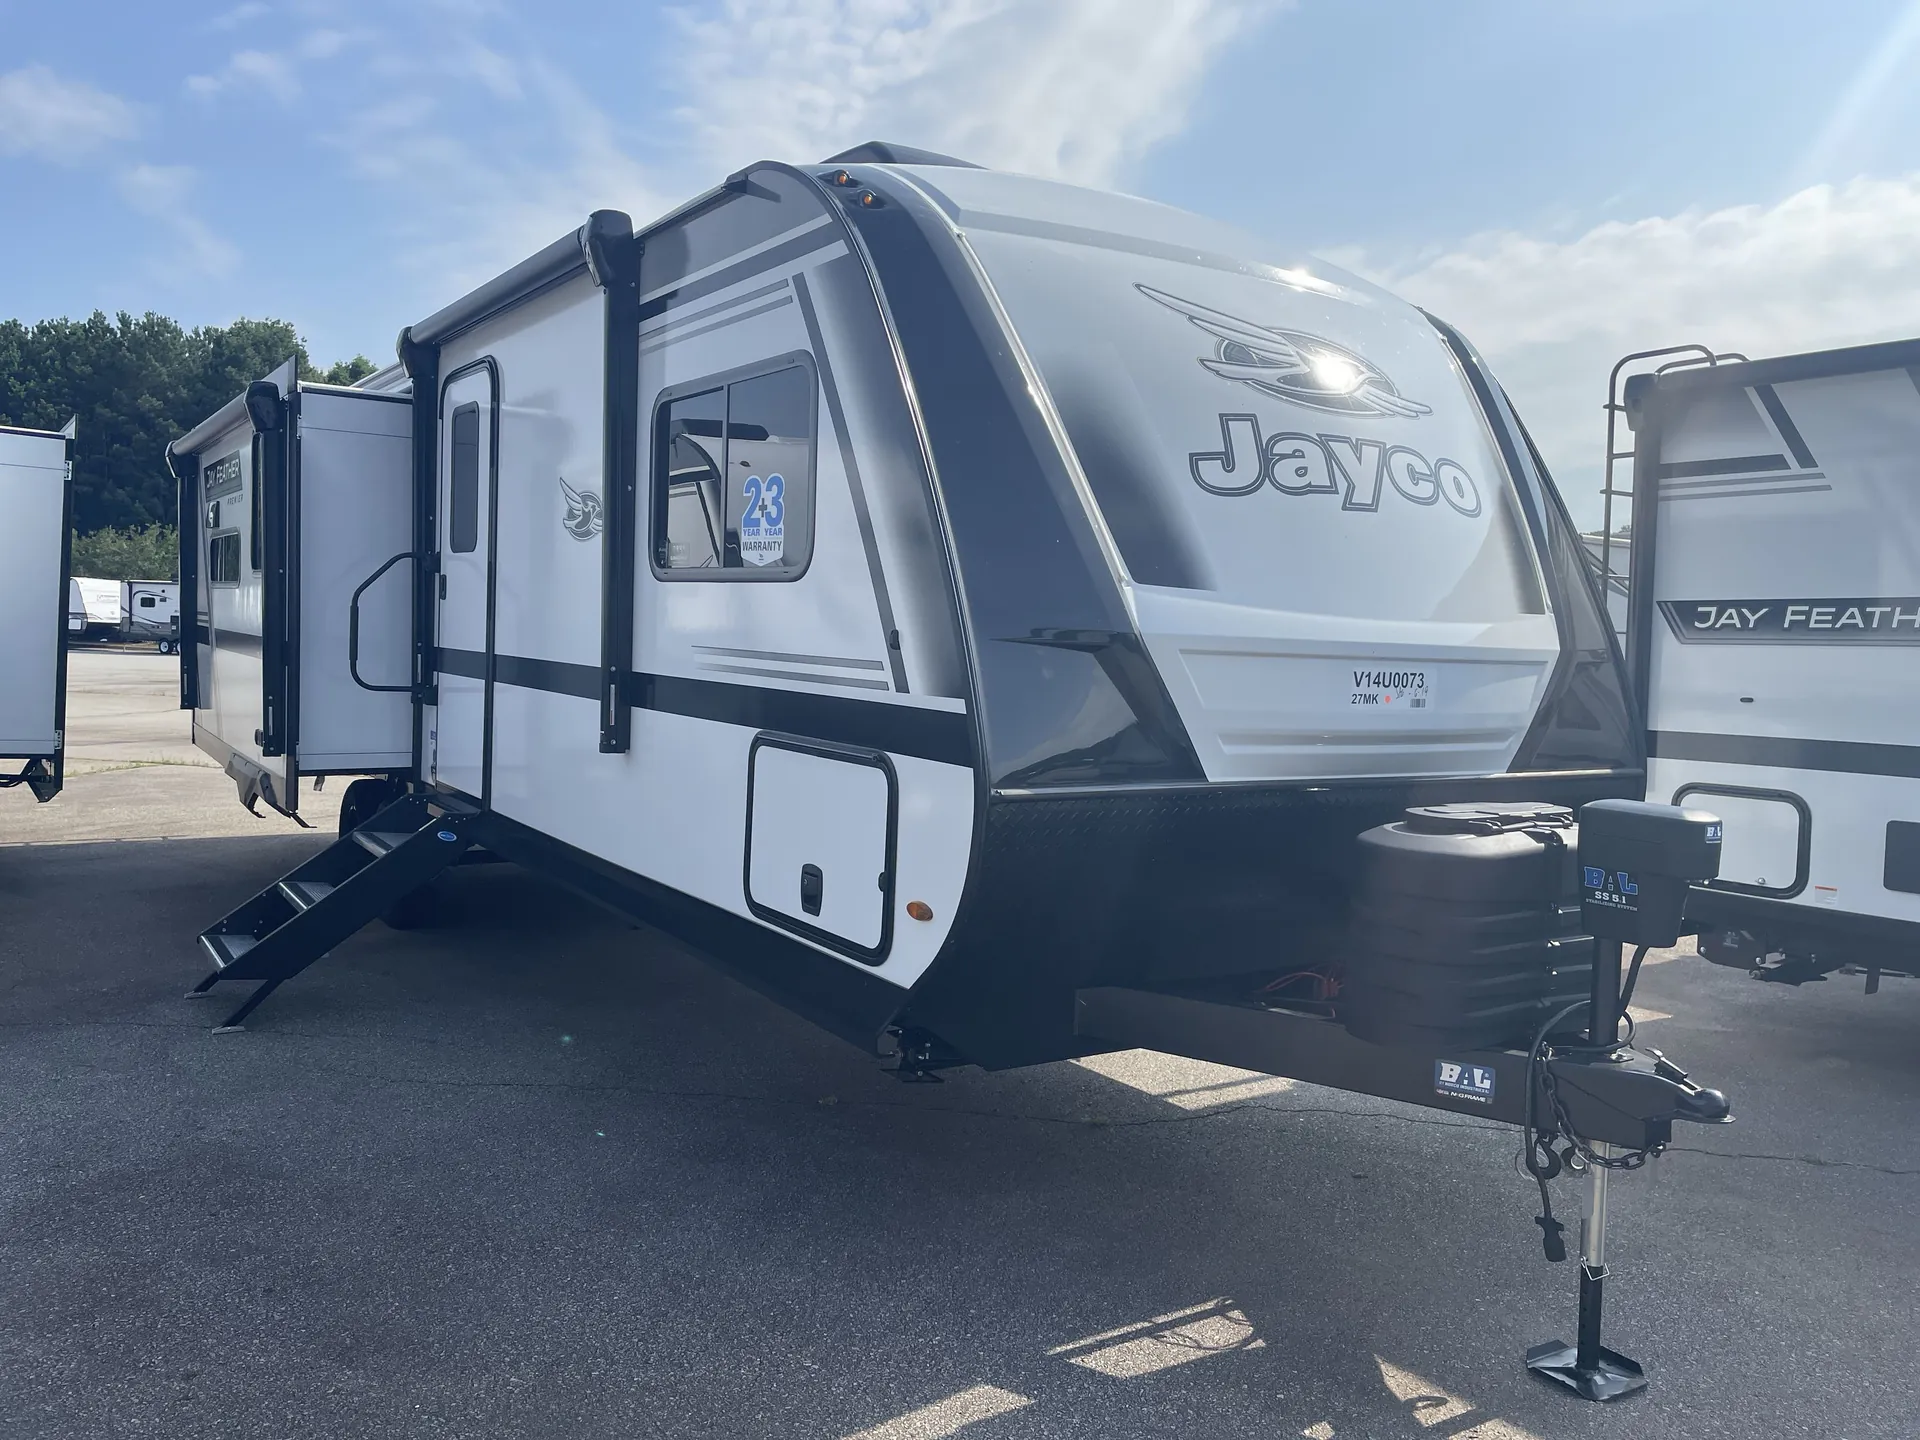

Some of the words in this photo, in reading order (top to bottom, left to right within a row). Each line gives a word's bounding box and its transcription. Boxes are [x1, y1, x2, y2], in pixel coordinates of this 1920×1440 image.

[207, 469, 216, 488] JAY
[216, 458, 240, 484] FEATHER
[1189, 413, 1482, 518] Jayco
[743, 528, 760, 537] YEAR
[764, 527, 783, 536] YEAR
[742, 541, 782, 551] WARRANTY
[1694, 606, 1769, 628] JAY
[1783, 605, 1920, 628] FEATH
[1353, 671, 1425, 688] V14U0073
[1351, 693, 1379, 705] 27MK
